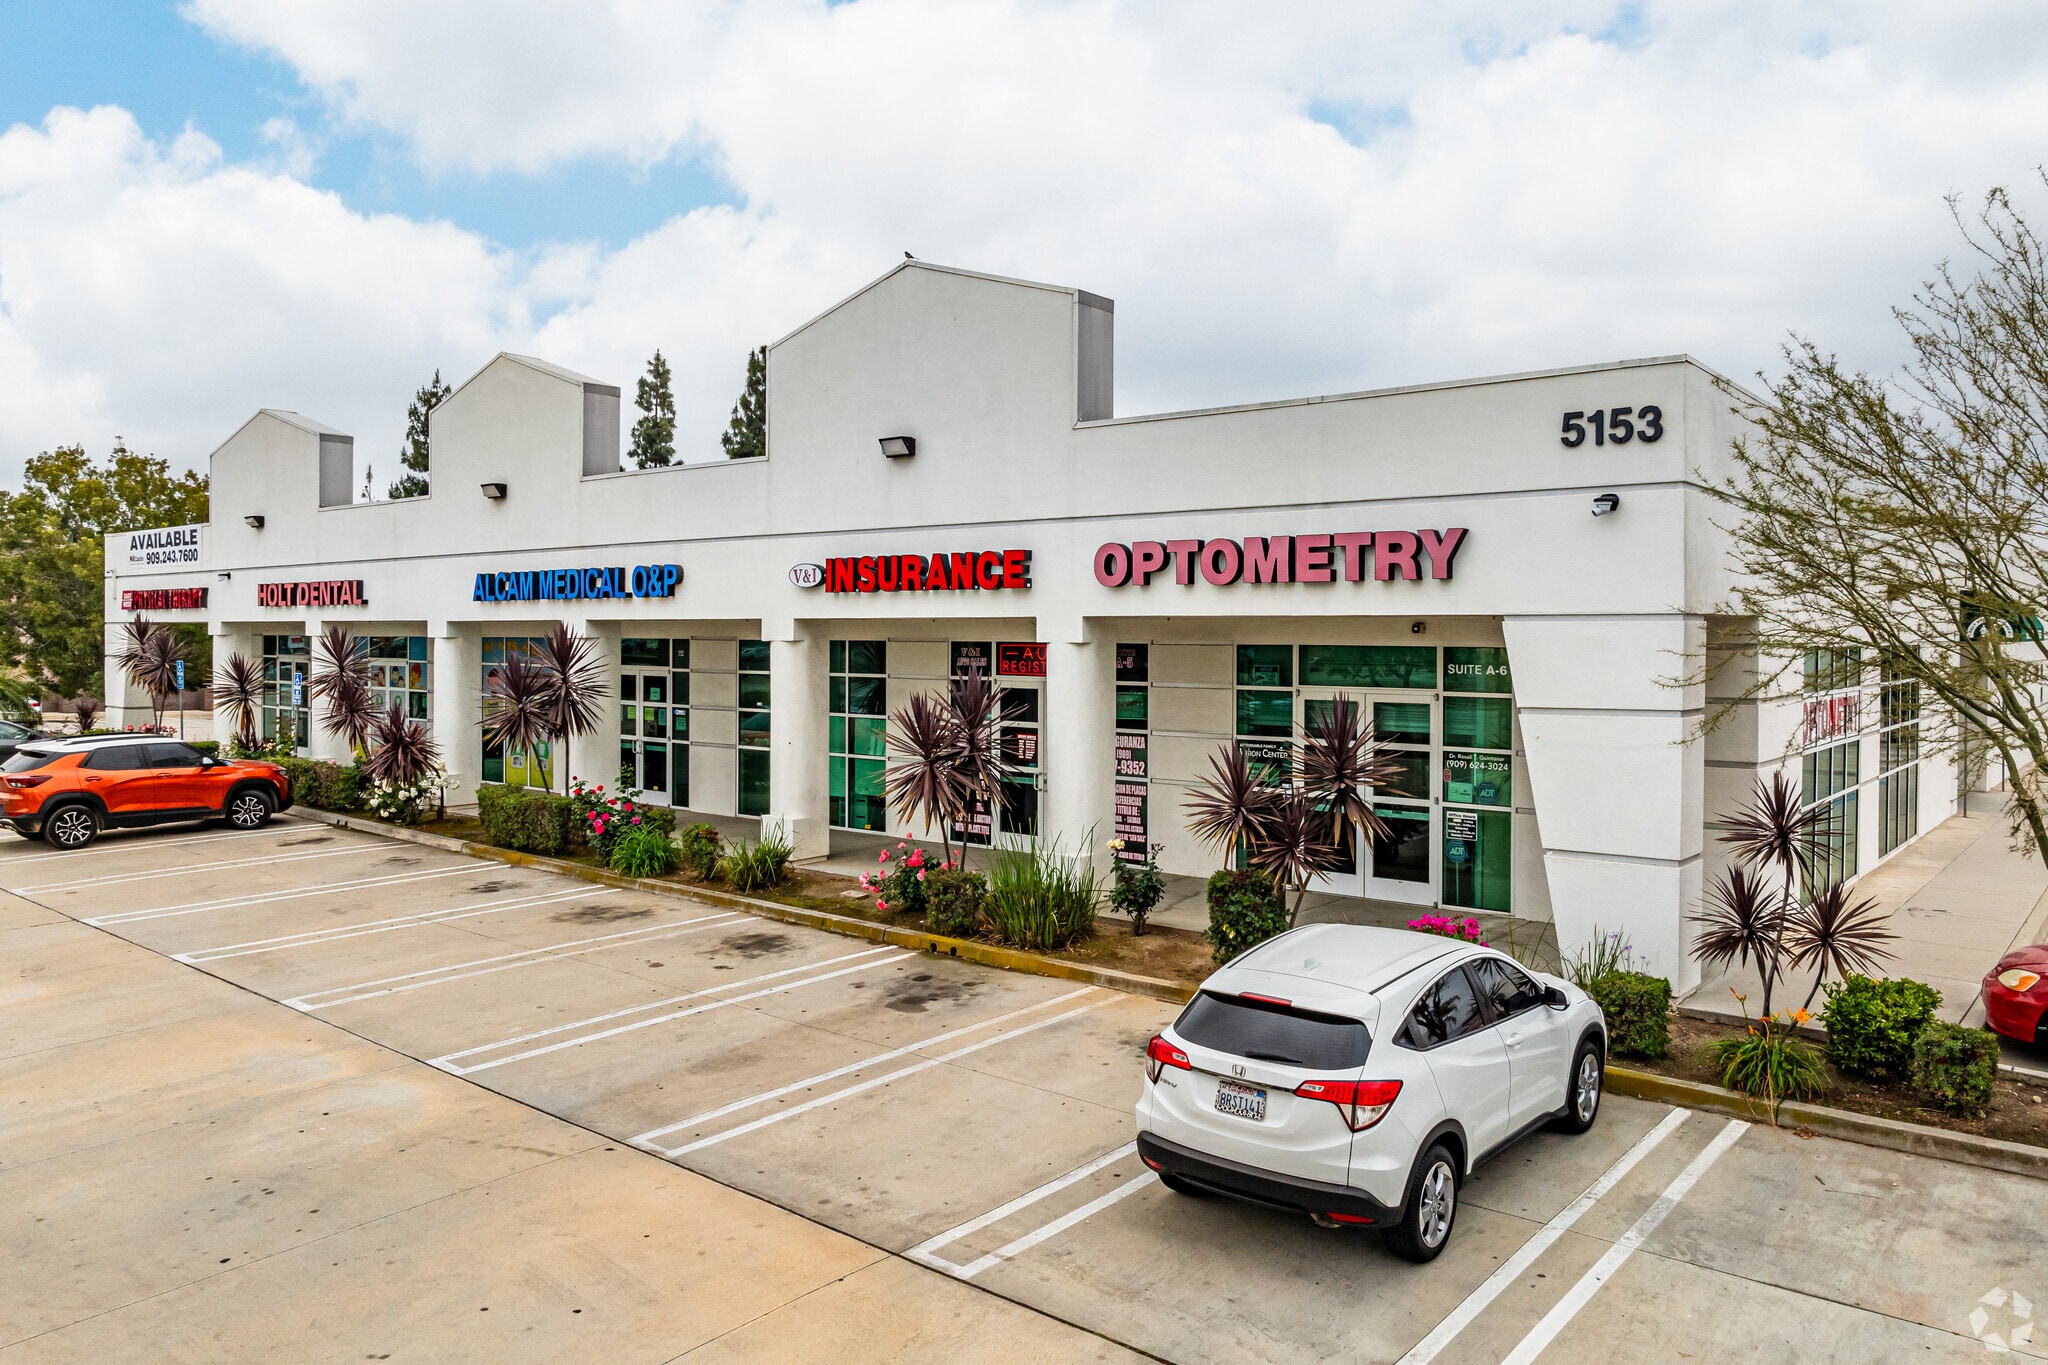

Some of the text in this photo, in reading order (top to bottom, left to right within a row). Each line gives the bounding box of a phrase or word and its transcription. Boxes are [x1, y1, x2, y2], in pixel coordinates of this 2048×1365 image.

[1561, 405, 1664, 448] 5153
[130, 529, 198, 551] AVAILABLE
[146, 548, 198, 565] 909.243.7600
[1094, 527, 1469, 588] OPTOMETRY
[793, 550, 1030, 593] V&I INSURANCE
[257, 580, 363, 607] HOLT DENTAL
[473, 564, 679, 602] ALCAM MEDICAL O&P
[961, 648, 981, 657] V&I
[1447, 664, 1508, 676] SUITE A-6
[1446, 760, 1509, 771] (909) 624-3024
[1480, 789, 1495, 797] ADT
[1450, 847, 1464, 855] ADT
[1219, 1092, 1262, 1115] 8RST141
